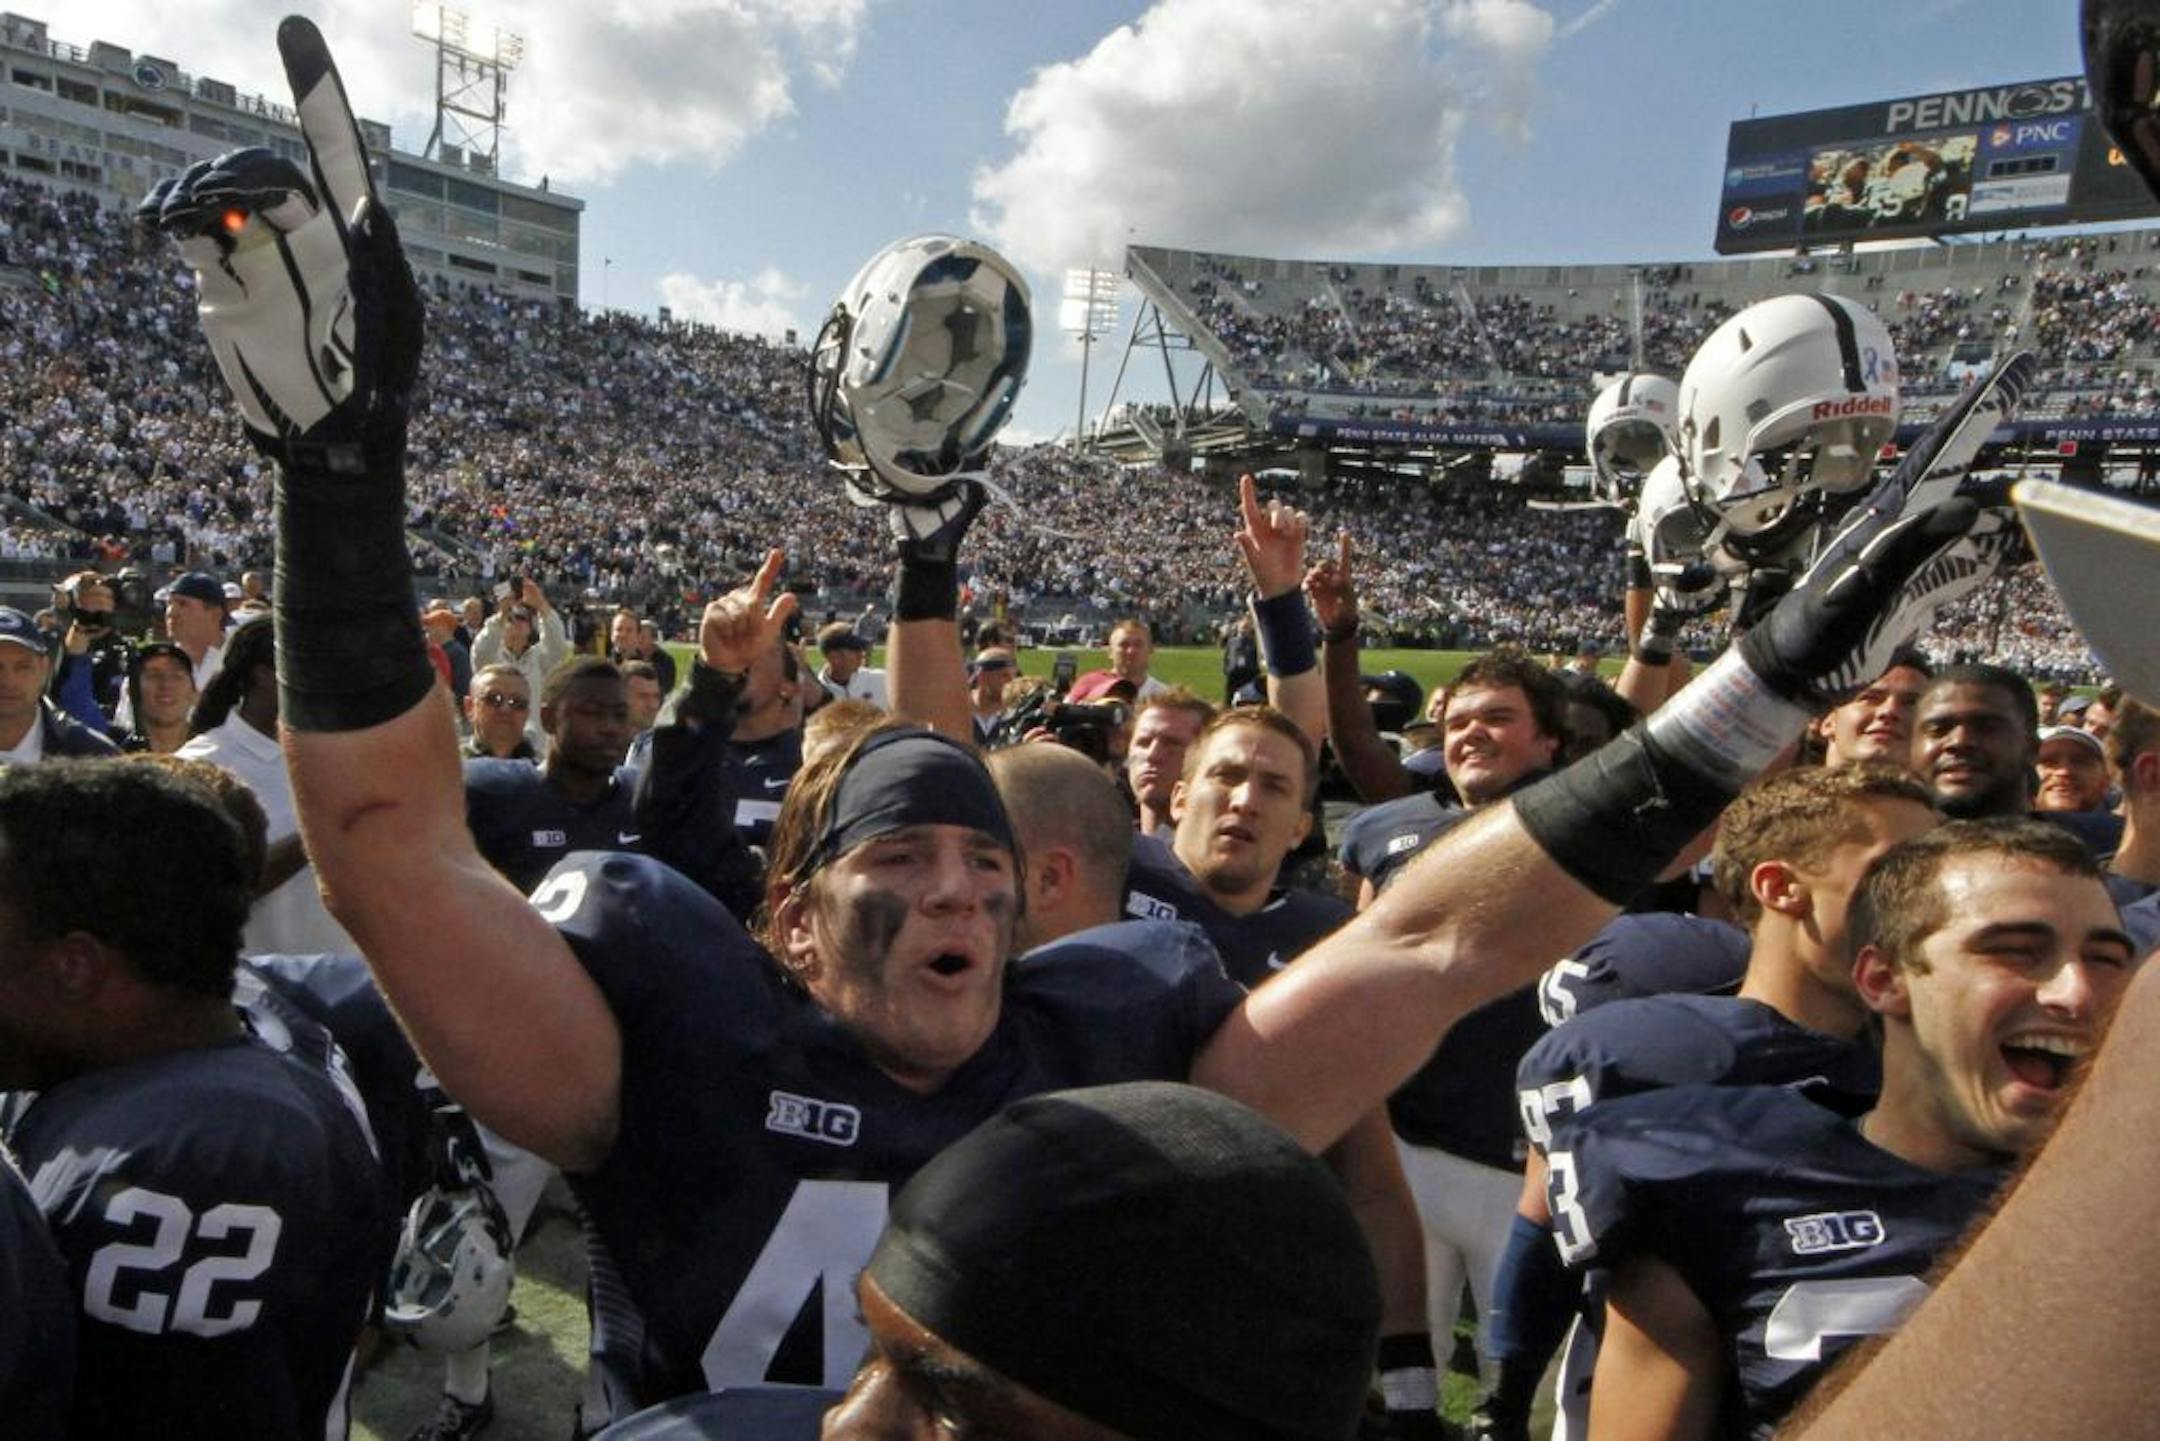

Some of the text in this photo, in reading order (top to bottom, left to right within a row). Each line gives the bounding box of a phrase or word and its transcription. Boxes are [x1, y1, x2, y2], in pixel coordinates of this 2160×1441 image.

[1886, 90, 2004, 133] PENN
[2015, 122, 2069, 145] PNC
[1813, 395, 1891, 420] Riddell
[1336, 427, 1370, 439] PENN
[1372, 429, 1410, 442] STATE
[1414, 432, 1449, 443] ALMA
[2045, 426, 2160, 441] PENN STATE
[84, 1186, 282, 1338] 22
